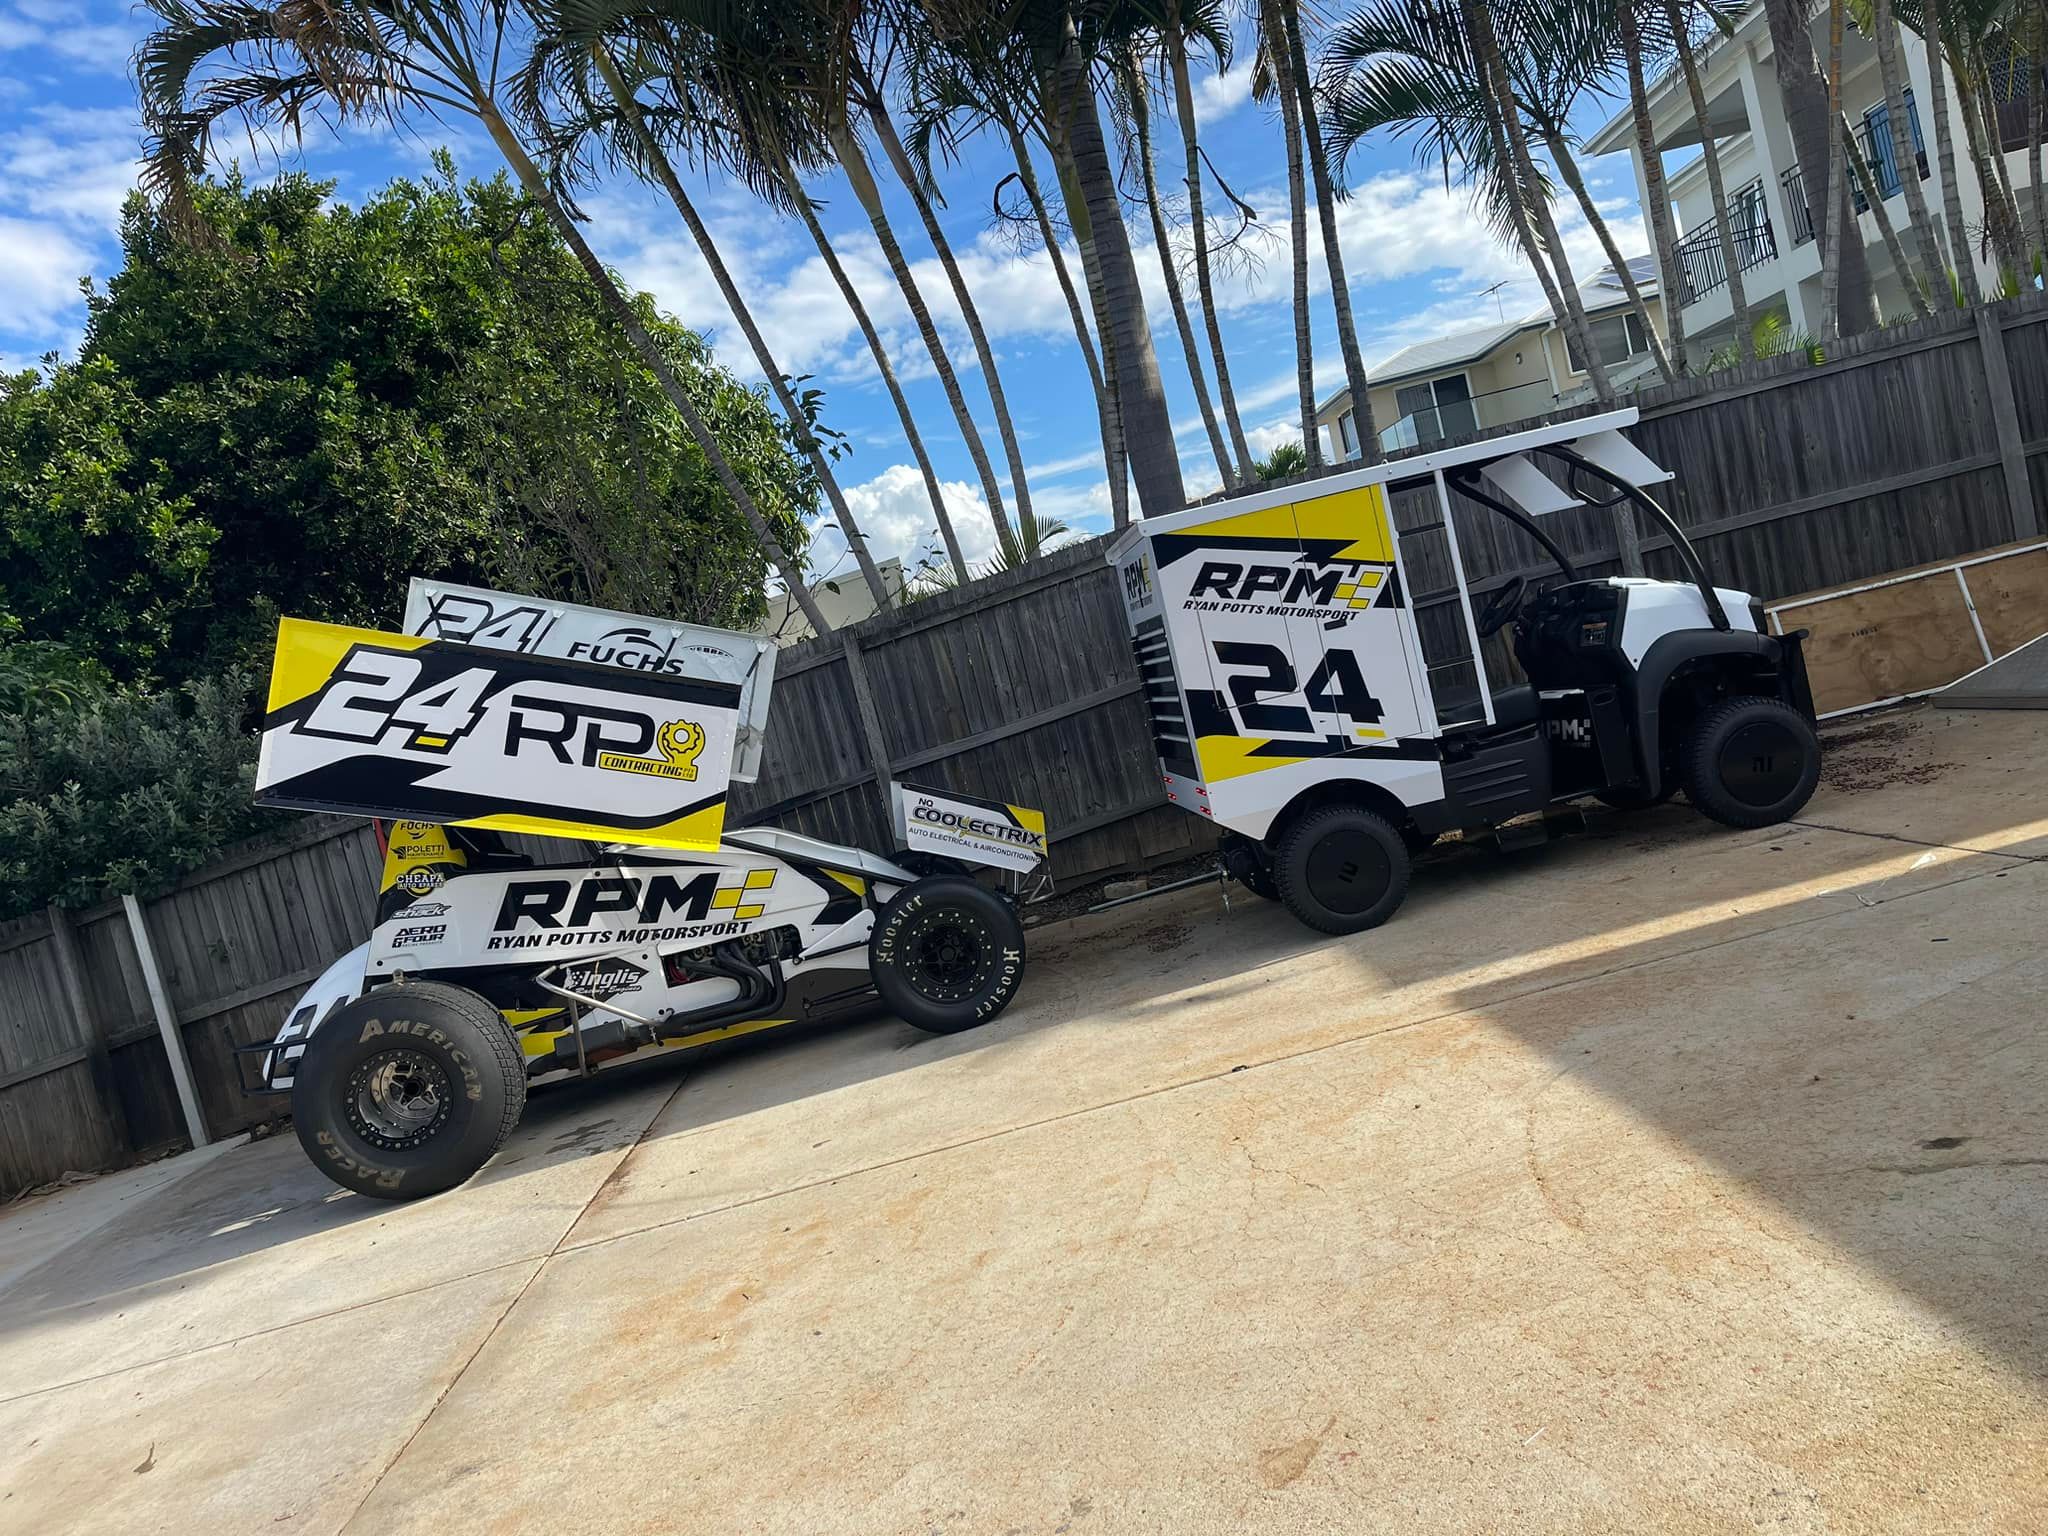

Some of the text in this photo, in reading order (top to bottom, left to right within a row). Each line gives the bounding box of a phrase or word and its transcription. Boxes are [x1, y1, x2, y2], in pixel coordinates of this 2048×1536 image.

[1189, 561, 1344, 606] RPM
[415, 594, 547, 653] 24
[1183, 600, 1360, 622] RYAN POTTS MOTORSPORT
[567, 641, 685, 675] FUCHS
[296, 645, 498, 750] 24
[1212, 640, 1386, 734] 24
[503, 694, 656, 768] RP
[604, 756, 683, 777] CONTRACTING
[908, 827, 1041, 864] AUTO ELECTRICAL & AIRCONDITIONING
[913, 806, 1043, 848] COOLECTRIX
[407, 844, 445, 853] POLETTI
[396, 874, 444, 883] CHEAPA
[493, 872, 720, 931] RPM
[396, 924, 447, 937] AERO
[487, 921, 753, 949] RYAN POTTS MOTORSPORT
[580, 969, 641, 988] Inglis
[976, 946, 1020, 1018] Hoosier
[359, 1018, 482, 1101] AMERICAN
[317, 1130, 407, 1188] RACER
